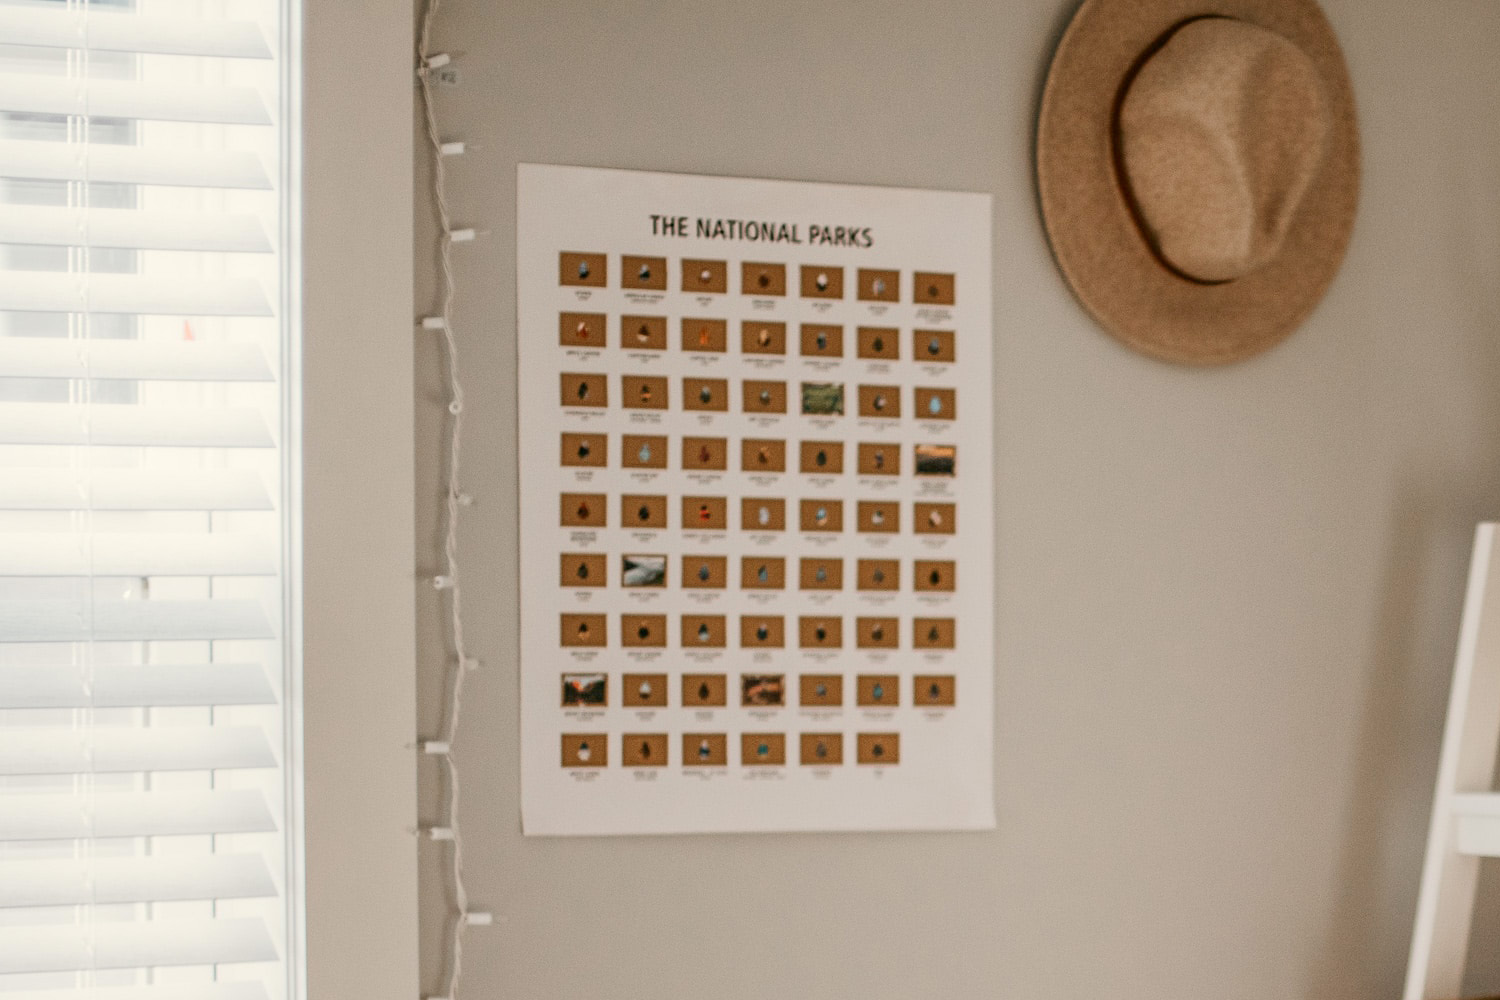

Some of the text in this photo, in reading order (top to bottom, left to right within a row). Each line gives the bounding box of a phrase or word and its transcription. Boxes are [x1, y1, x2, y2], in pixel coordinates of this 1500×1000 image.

[649, 214, 874, 249] THE NATIONAL PARKS
